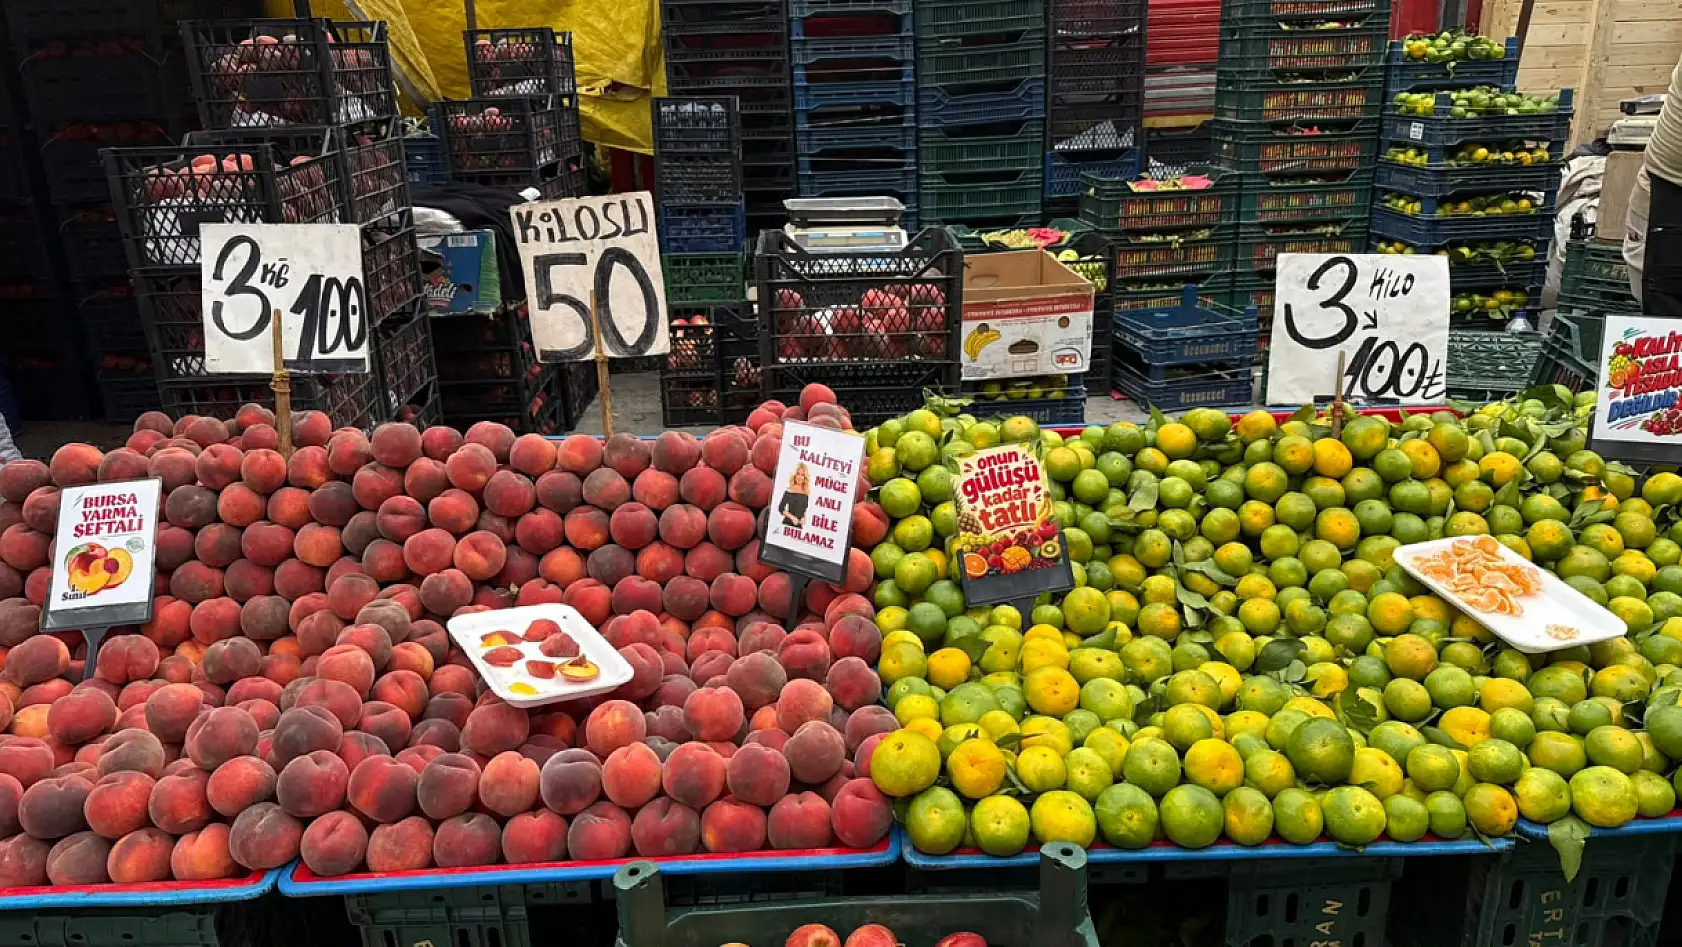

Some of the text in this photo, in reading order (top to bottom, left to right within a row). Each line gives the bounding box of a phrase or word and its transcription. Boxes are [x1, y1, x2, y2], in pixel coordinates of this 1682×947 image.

[212, 235, 271, 341] 3
[533, 247, 659, 361] 50
[1284, 256, 1358, 349] 3
[290, 274, 367, 363] 100
[1641, 355, 1679, 376] ASLA
[793, 435, 811, 447] BU
[800, 449, 853, 475] KALİTEYİ
[977, 451, 1018, 469] onun
[815, 476, 848, 493] MÜGE
[962, 461, 1039, 504] gülüşü
[83, 493, 137, 508] BURSA
[815, 496, 842, 512] ANLI
[982, 487, 1030, 508] kadar
[82, 506, 137, 522] YARMA
[811, 514, 838, 532] BİLE
[979, 501, 1036, 530] tatlı
[73, 514, 144, 538] ŞEFTALİ
[783, 526, 834, 549] BULAMAZ
